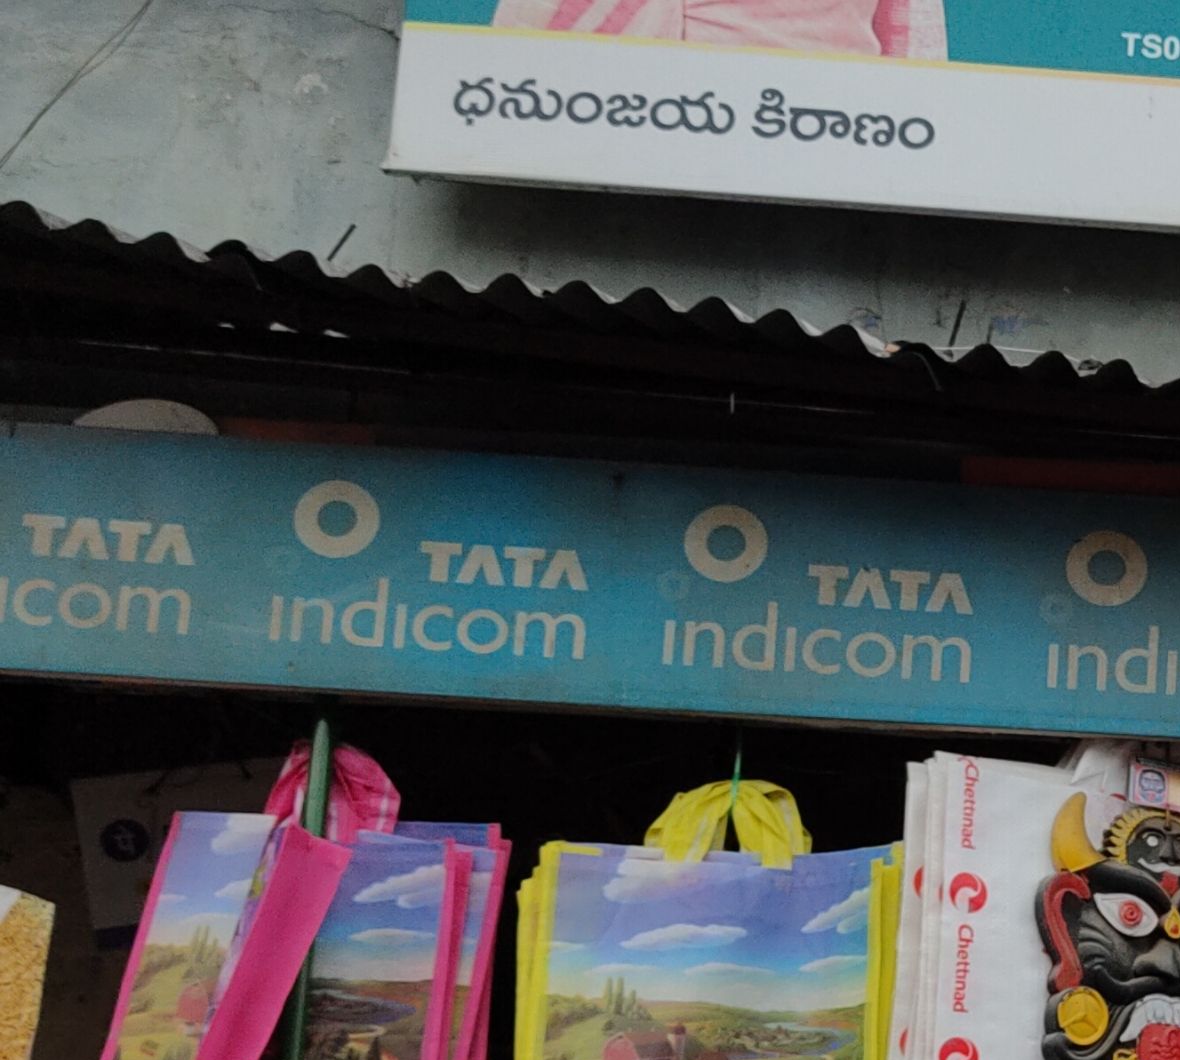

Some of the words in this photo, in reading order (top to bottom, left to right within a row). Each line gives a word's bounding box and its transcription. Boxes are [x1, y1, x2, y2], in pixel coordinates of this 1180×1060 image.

[452, 75, 736, 138] ధనుంజయ
[751, 87, 936, 151] కిరాణం
[22, 512, 196, 566] TATA
[419, 541, 589, 592] TATA
[267, 577, 588, 661] indicom
[807, 563, 974, 615] TATA
[661, 601, 971, 684] indicom
[959, 762, 981, 850] Chettinad
[953, 923, 975, 1014] Chettinad
